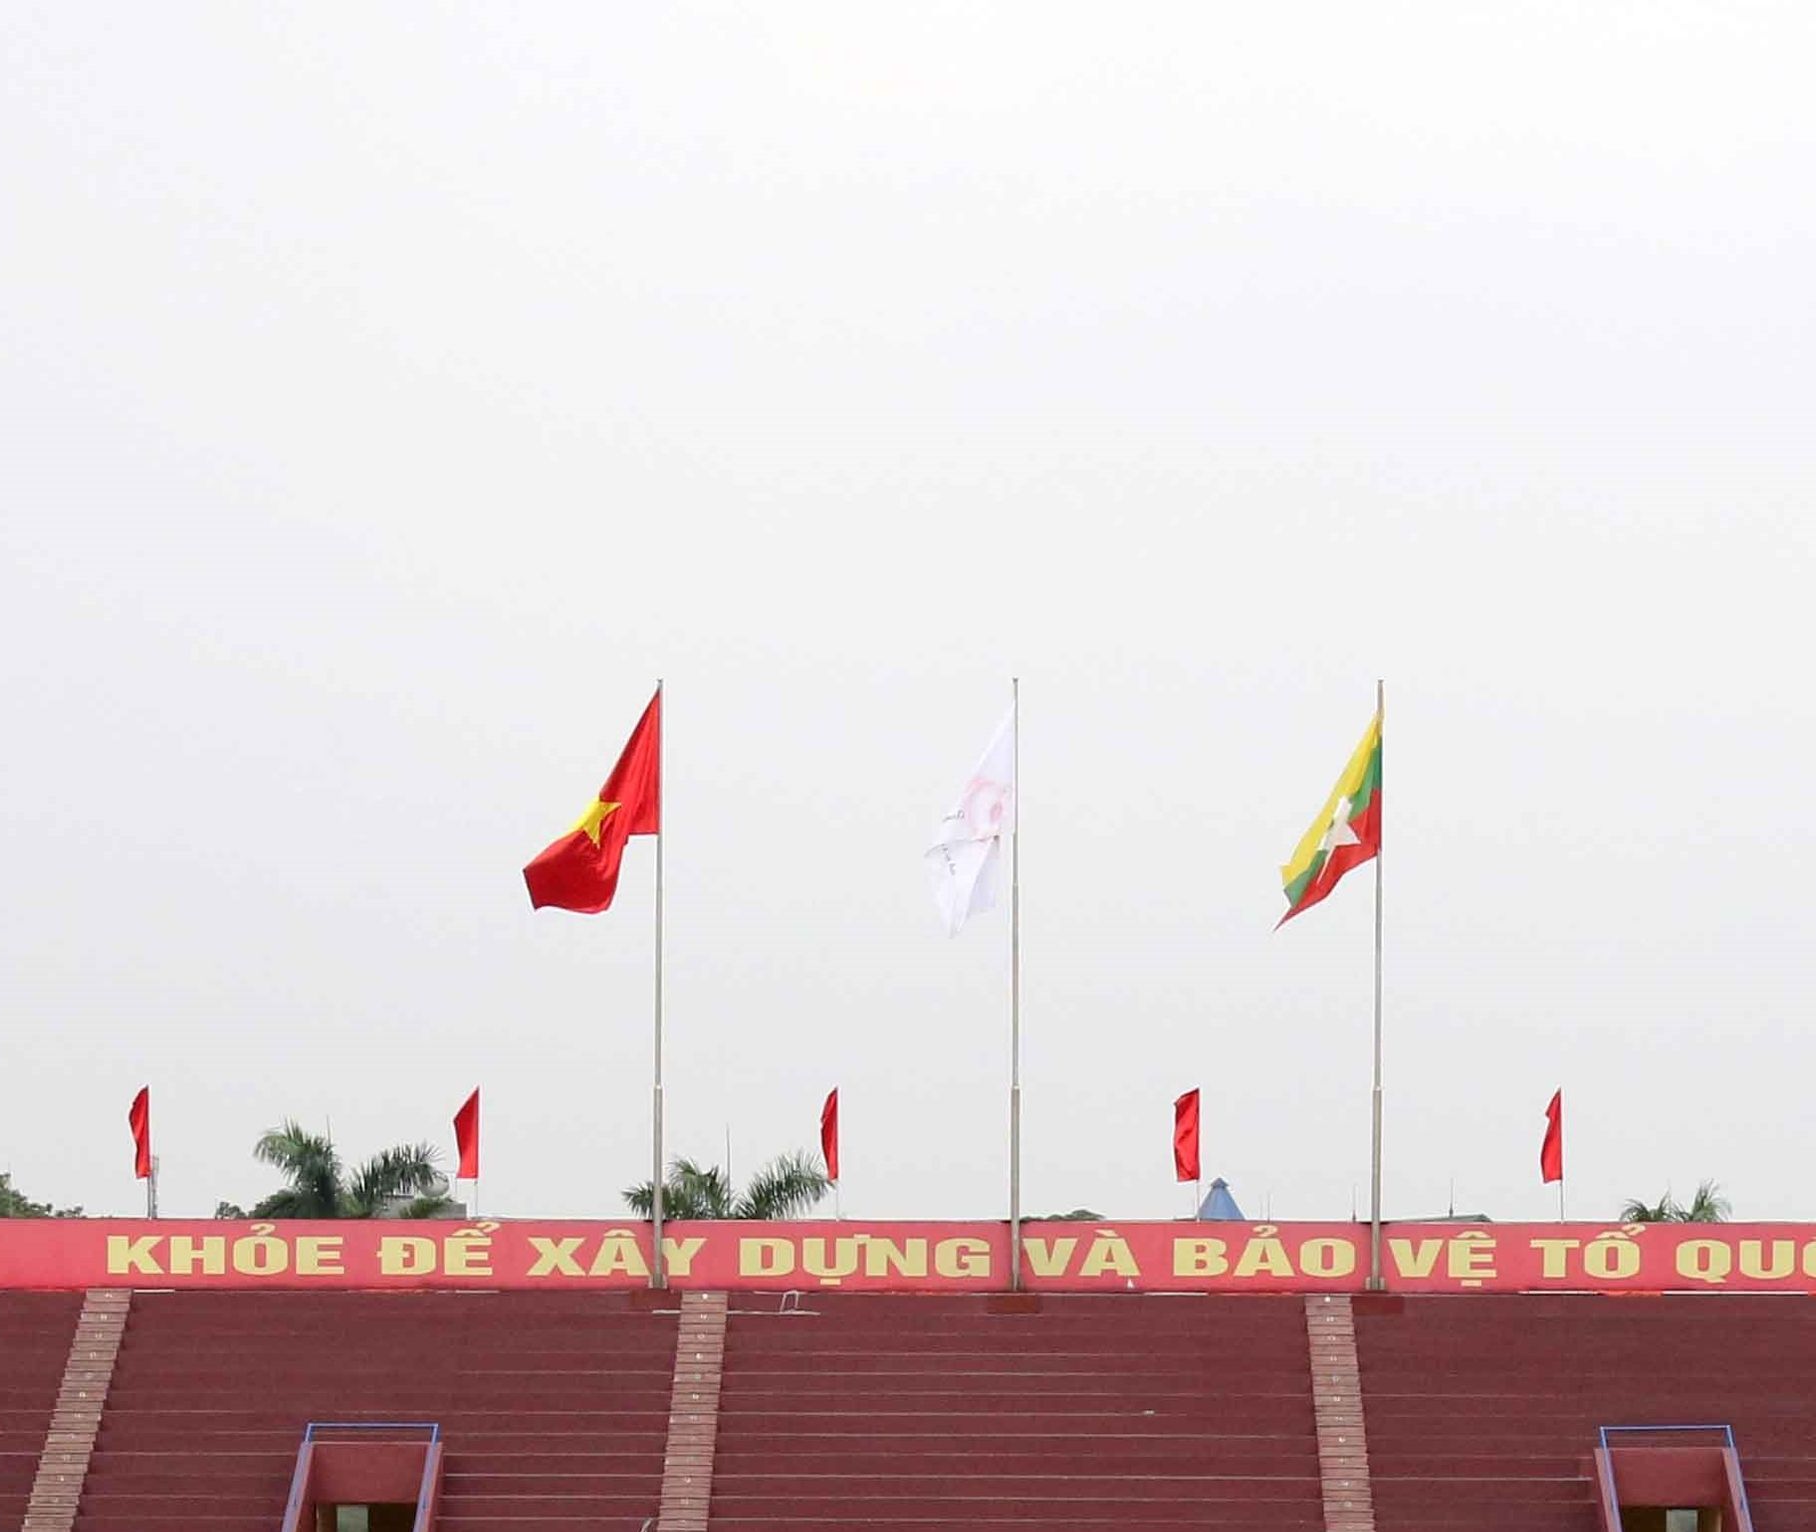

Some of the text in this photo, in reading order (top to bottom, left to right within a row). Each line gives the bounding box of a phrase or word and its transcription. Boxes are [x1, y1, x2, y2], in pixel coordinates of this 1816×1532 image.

[106, 1224, 344, 1274] KHỎE
[377, 1221, 500, 1276] ĐỂ
[527, 1230, 708, 1276] XÂY
[739, 1234, 991, 1285] DỰNG
[1022, 1229, 1141, 1276] VÀ
[1172, 1225, 1357, 1277] BẢO
[1387, 1231, 1497, 1287] VỆ
[1530, 1225, 1645, 1279] TỔ
